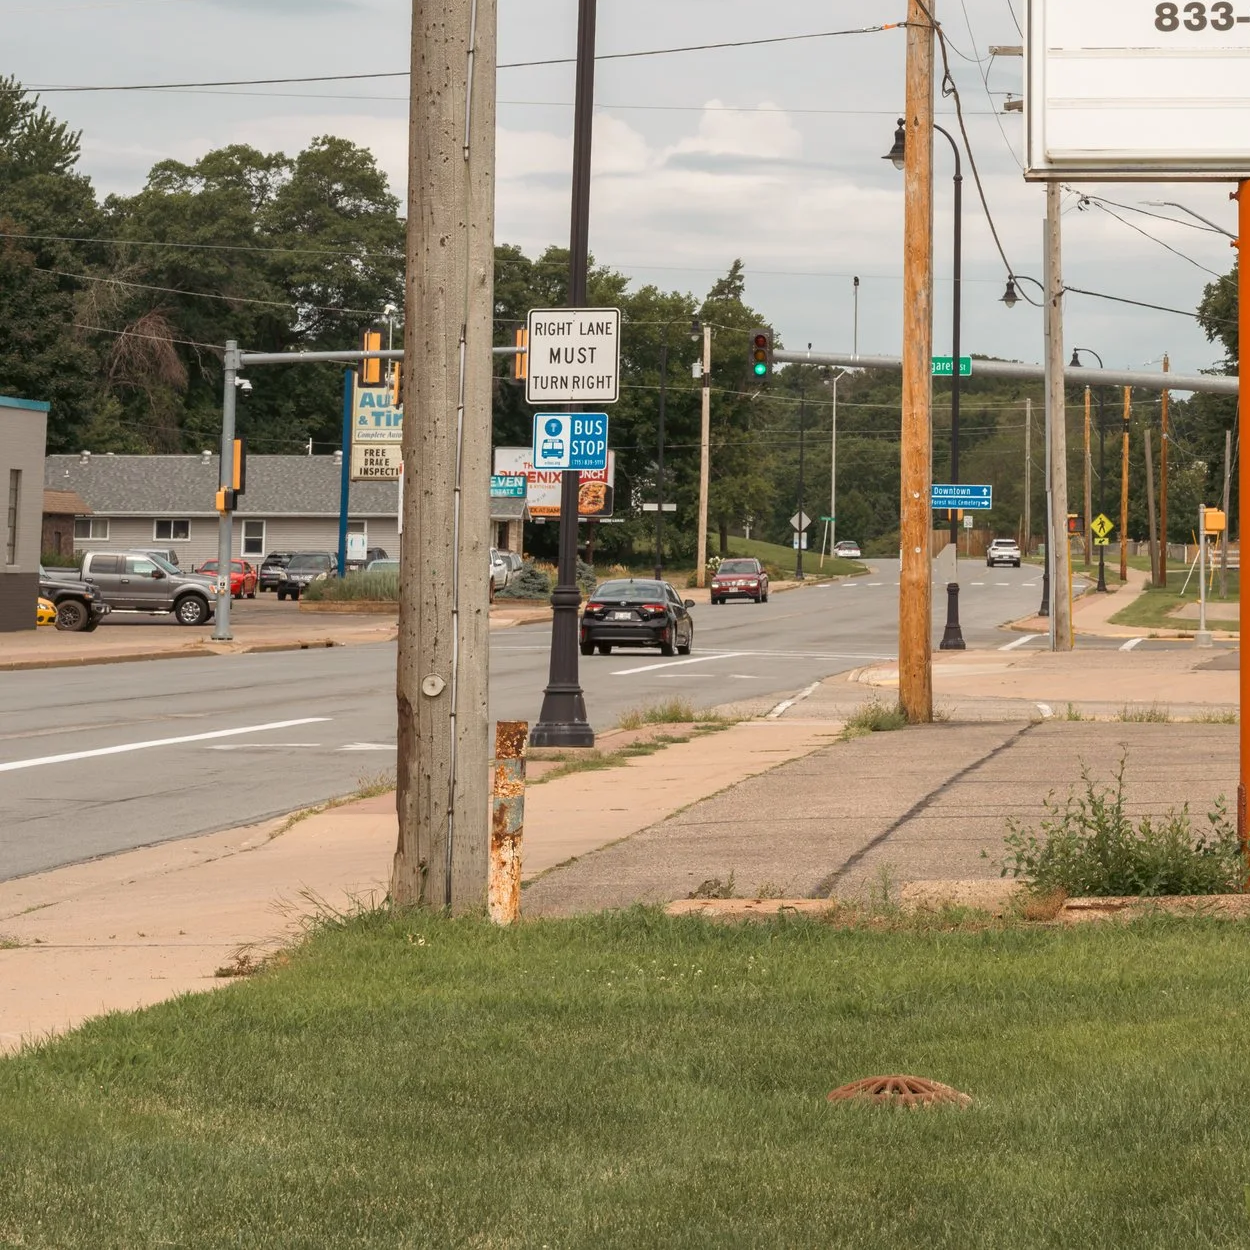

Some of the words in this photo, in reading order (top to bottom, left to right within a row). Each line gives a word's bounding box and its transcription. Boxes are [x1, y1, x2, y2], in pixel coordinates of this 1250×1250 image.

[535, 322, 573, 336] RIGHT
[580, 321, 613, 335] LANE
[549, 347, 597, 364] MUST
[932, 361, 953, 373] garet
[532, 376, 568, 390] TURN
[572, 375, 613, 389] RIGHT
[358, 415, 368, 426] &
[371, 410, 403, 427] Tir
[574, 420, 603, 435] BUS
[357, 431, 386, 440] Complete
[364, 448, 386, 457] FREE
[571, 440, 604, 455] STOP
[364, 458, 389, 467] BRAKE
[523, 461, 533, 469] TH
[360, 467, 399, 476] INSPECTI
[579, 469, 605, 479] UNCH
[933, 486, 971, 495] Downtown
[957, 499, 981, 507] Cemetery
